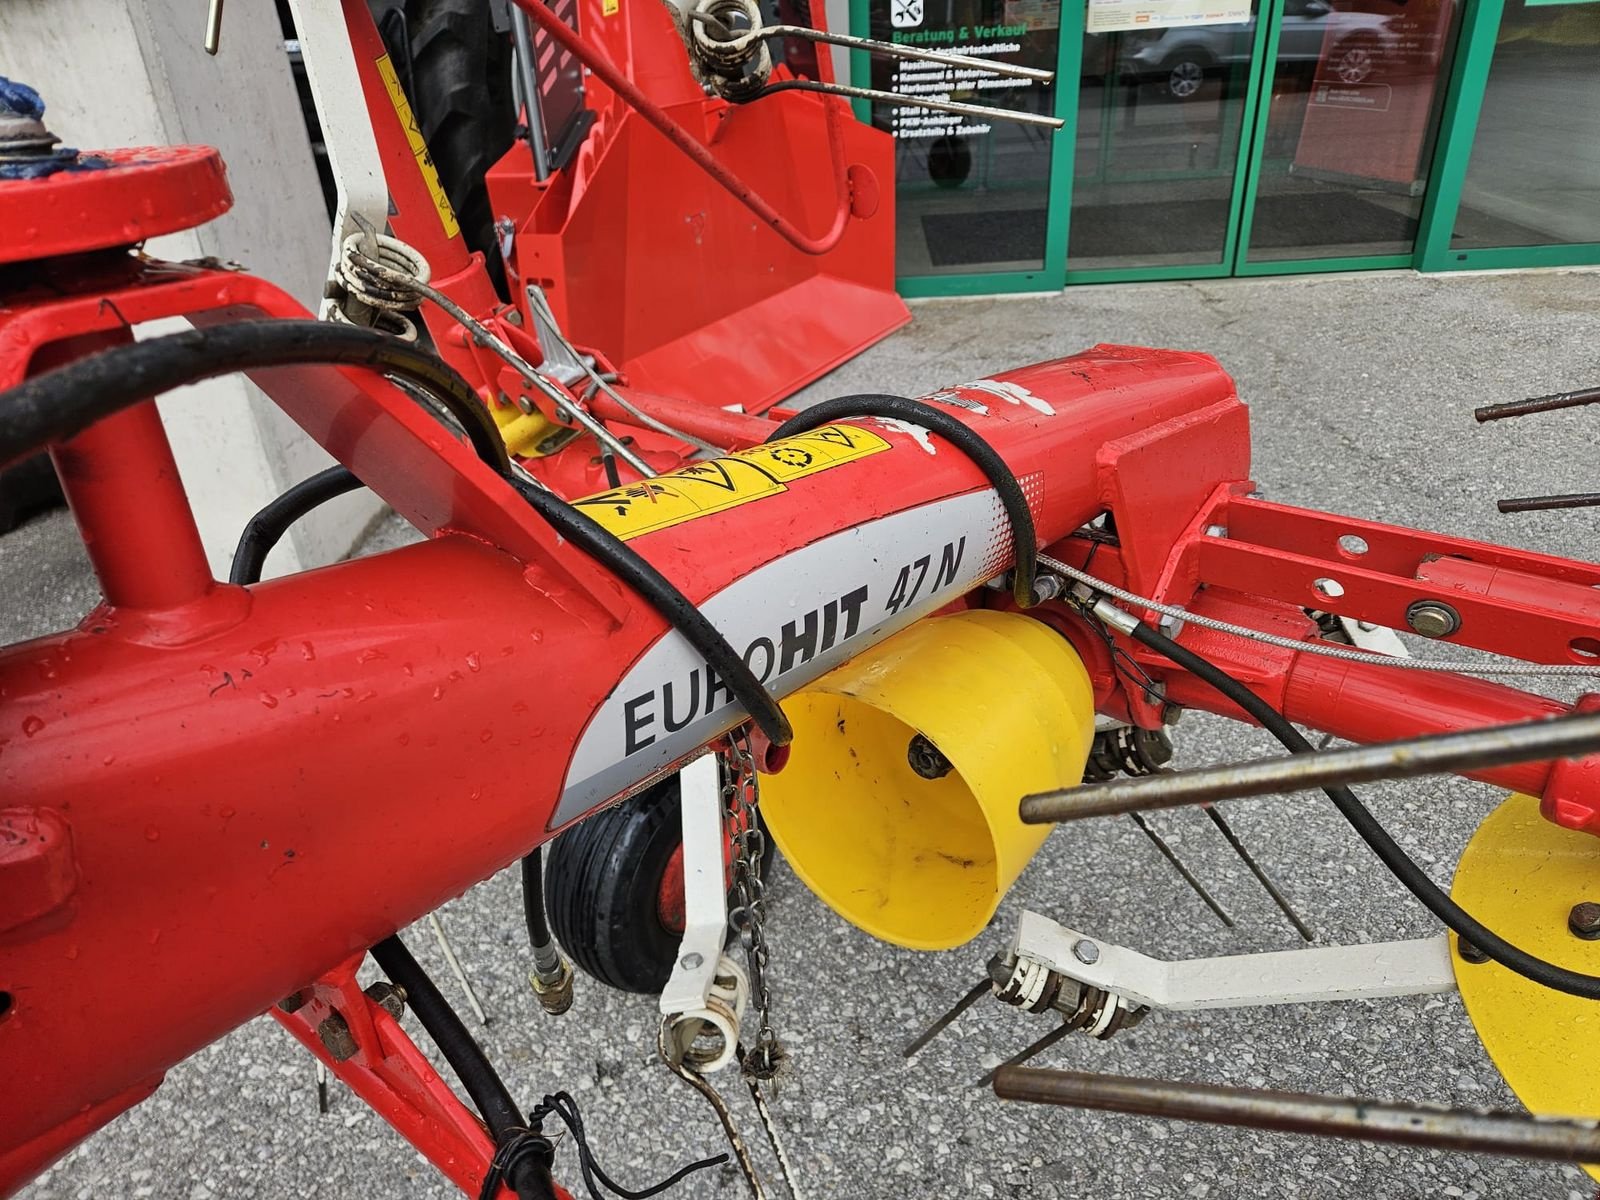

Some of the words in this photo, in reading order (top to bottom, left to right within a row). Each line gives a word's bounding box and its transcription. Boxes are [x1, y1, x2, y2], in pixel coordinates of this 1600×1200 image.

[892, 30, 954, 43] Beratung
[959, 26, 969, 39] &
[974, 23, 1027, 39] Verkauf
[900, 70, 944, 82] Kommunal
[946, 69, 953, 80] &
[900, 82, 955, 93] Markenreifen
[956, 81, 976, 91] aller
[978, 78, 1032, 89] Dimensionen
[900, 115, 963, 127] PKW-Anhänger
[900, 127, 945, 138] Ersatzteile
[947, 126, 954, 136] &
[956, 123, 991, 135] Zubehör
[624, 585, 868, 757] EUROHIT
[885, 554, 930, 616] 47
[931, 536, 966, 594] N
